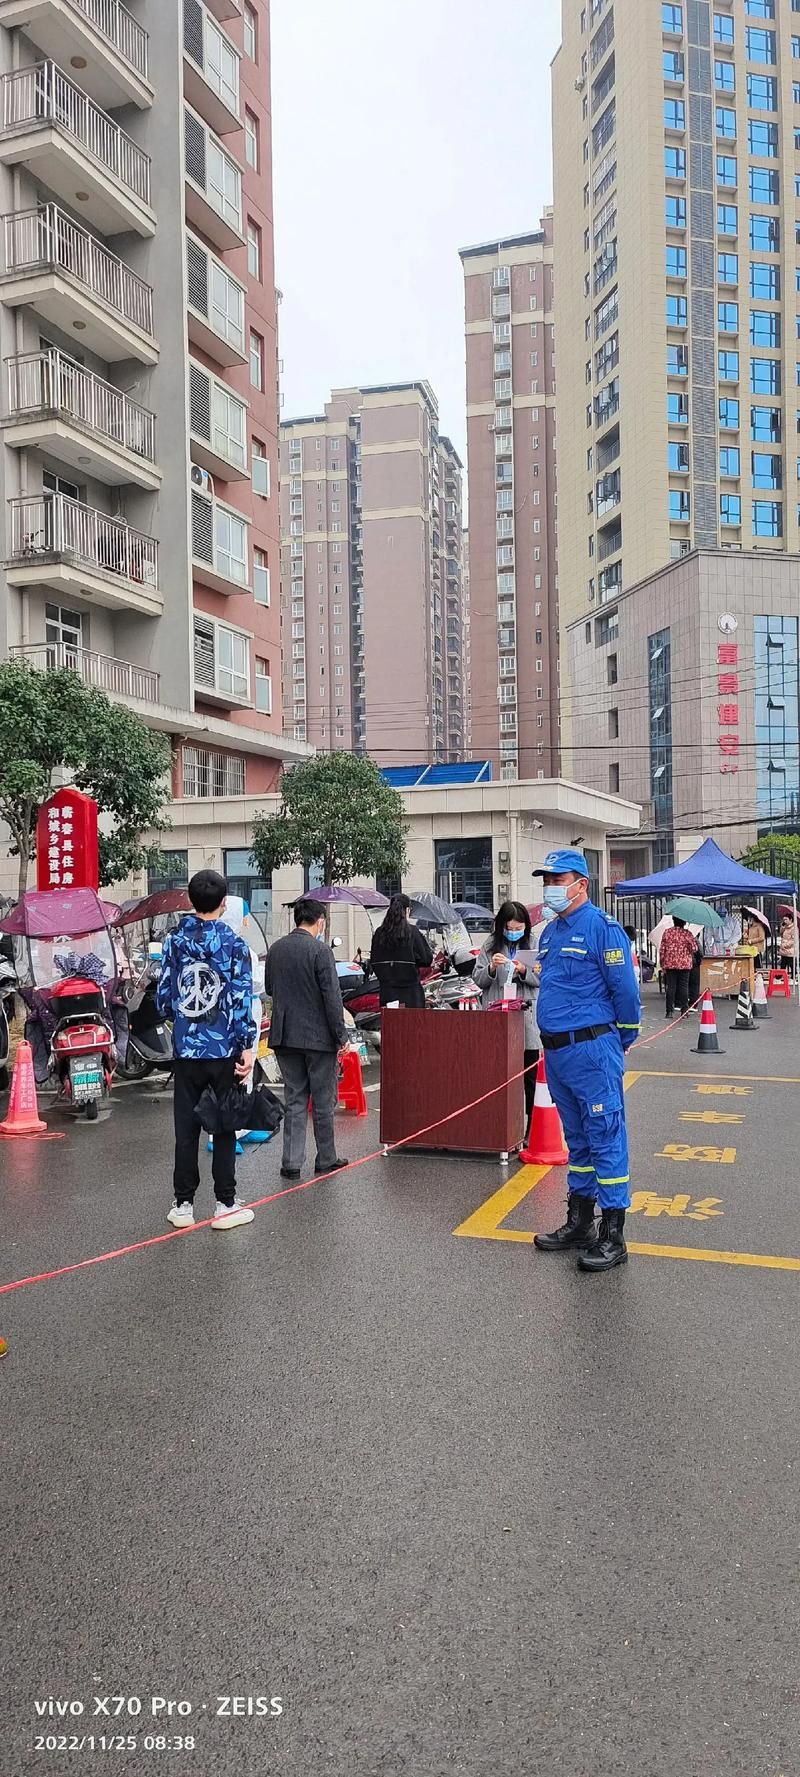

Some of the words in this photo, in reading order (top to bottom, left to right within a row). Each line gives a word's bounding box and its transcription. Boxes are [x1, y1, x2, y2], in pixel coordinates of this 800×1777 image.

[47, 807, 60, 884] 和城乡建设局
[61, 806, 74, 884] 蕲春县住房
